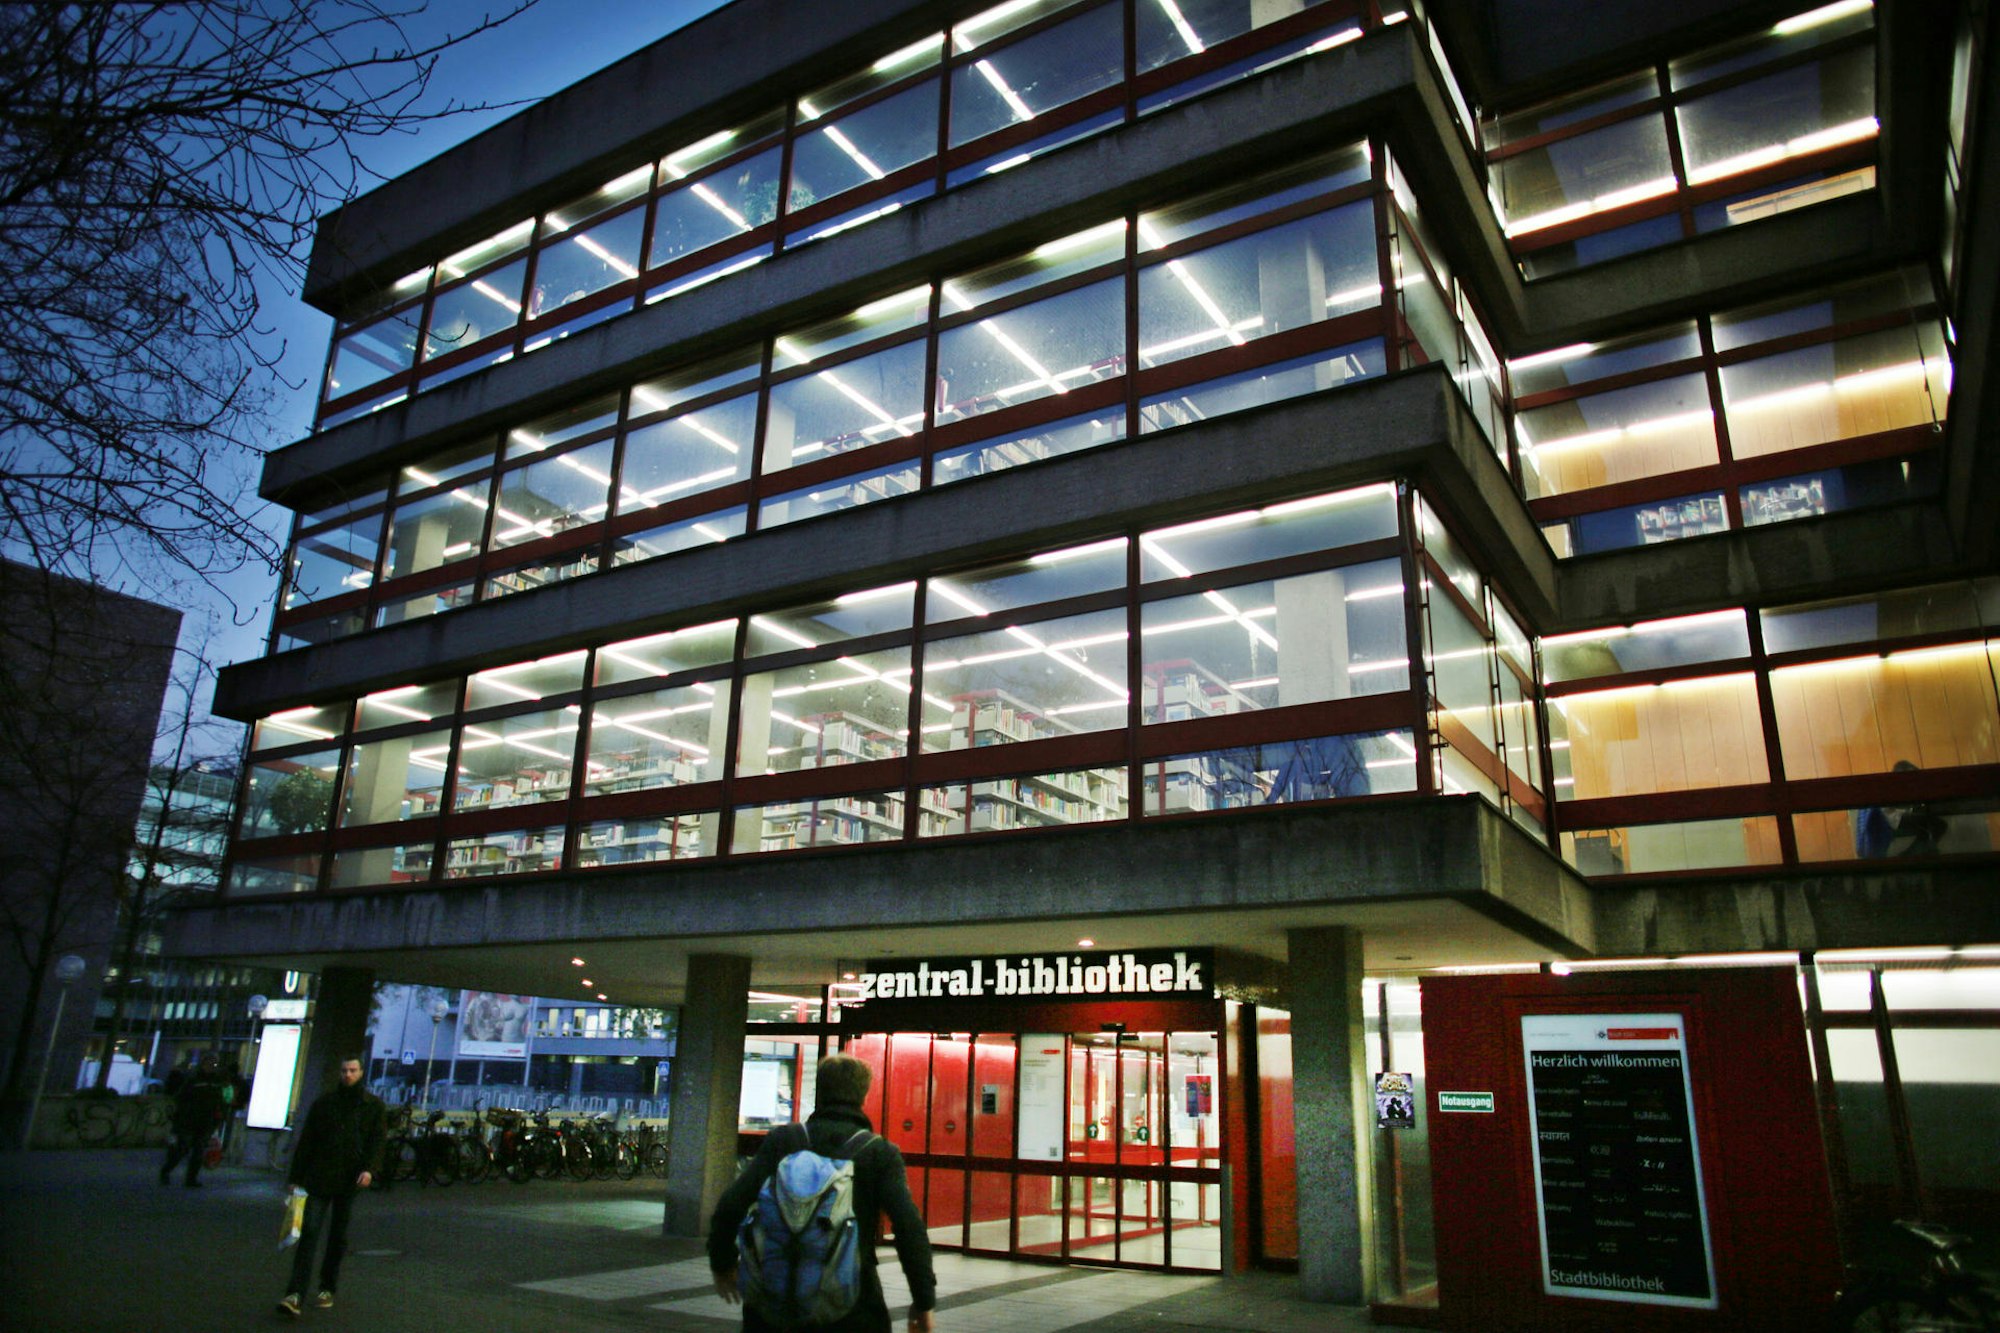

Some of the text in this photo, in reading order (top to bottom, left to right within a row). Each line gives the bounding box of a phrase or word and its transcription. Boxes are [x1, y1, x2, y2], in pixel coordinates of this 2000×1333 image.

[284, 970, 300, 994] U
[858, 953, 1203, 999] zentral-bibliothek
[1532, 1055, 1681, 1069] Herzlich willkommen
[1441, 1096, 1492, 1109] Notausgang
[1550, 1269, 1665, 1292] Stadtbibliothek
